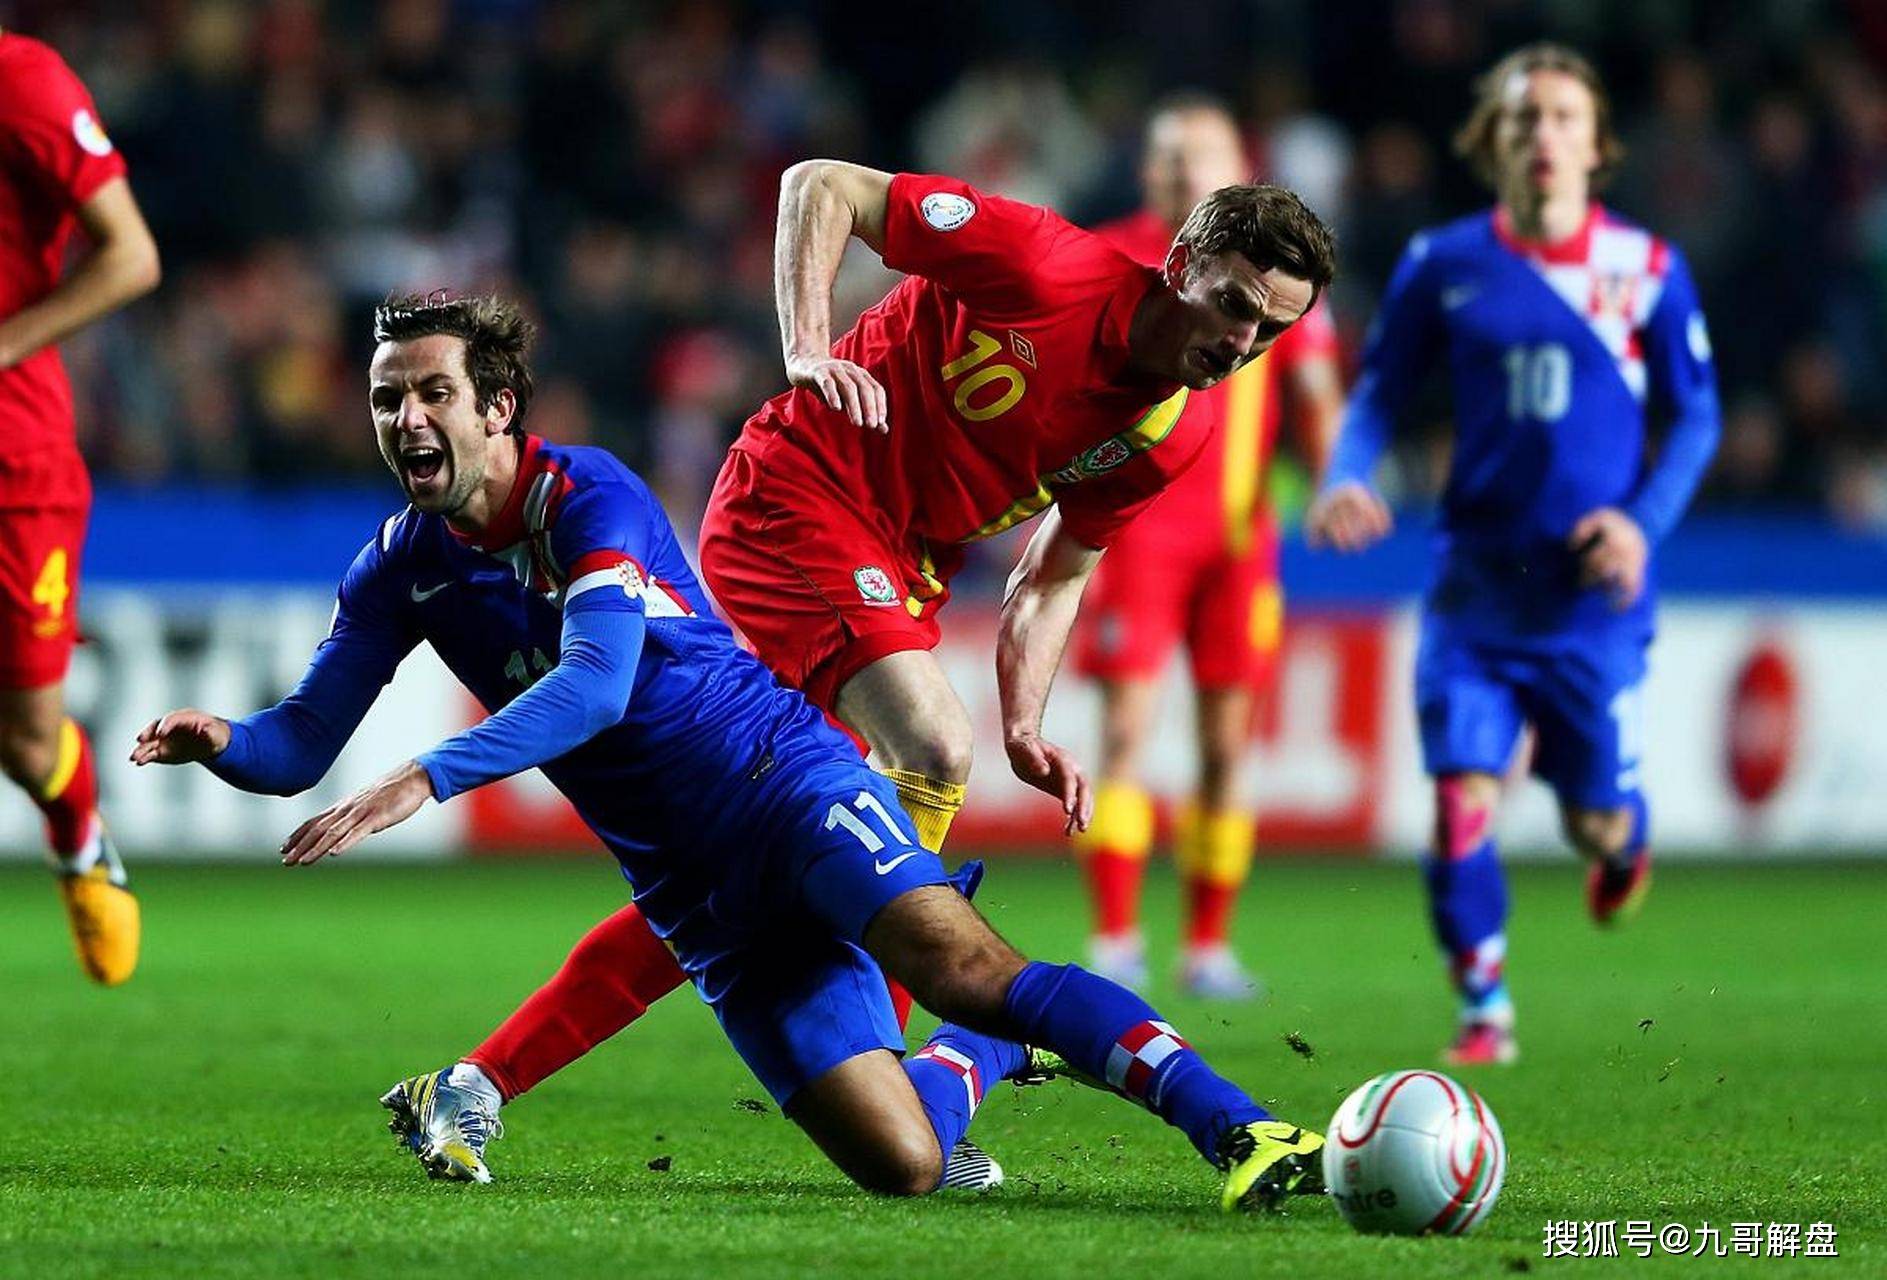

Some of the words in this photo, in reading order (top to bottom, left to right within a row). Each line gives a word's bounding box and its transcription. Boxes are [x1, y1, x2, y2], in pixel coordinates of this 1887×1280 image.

[942, 330, 1026, 421] 10
[1502, 343, 1571, 421] 10
[32, 547, 68, 618] 4
[824, 791, 912, 853] 11
